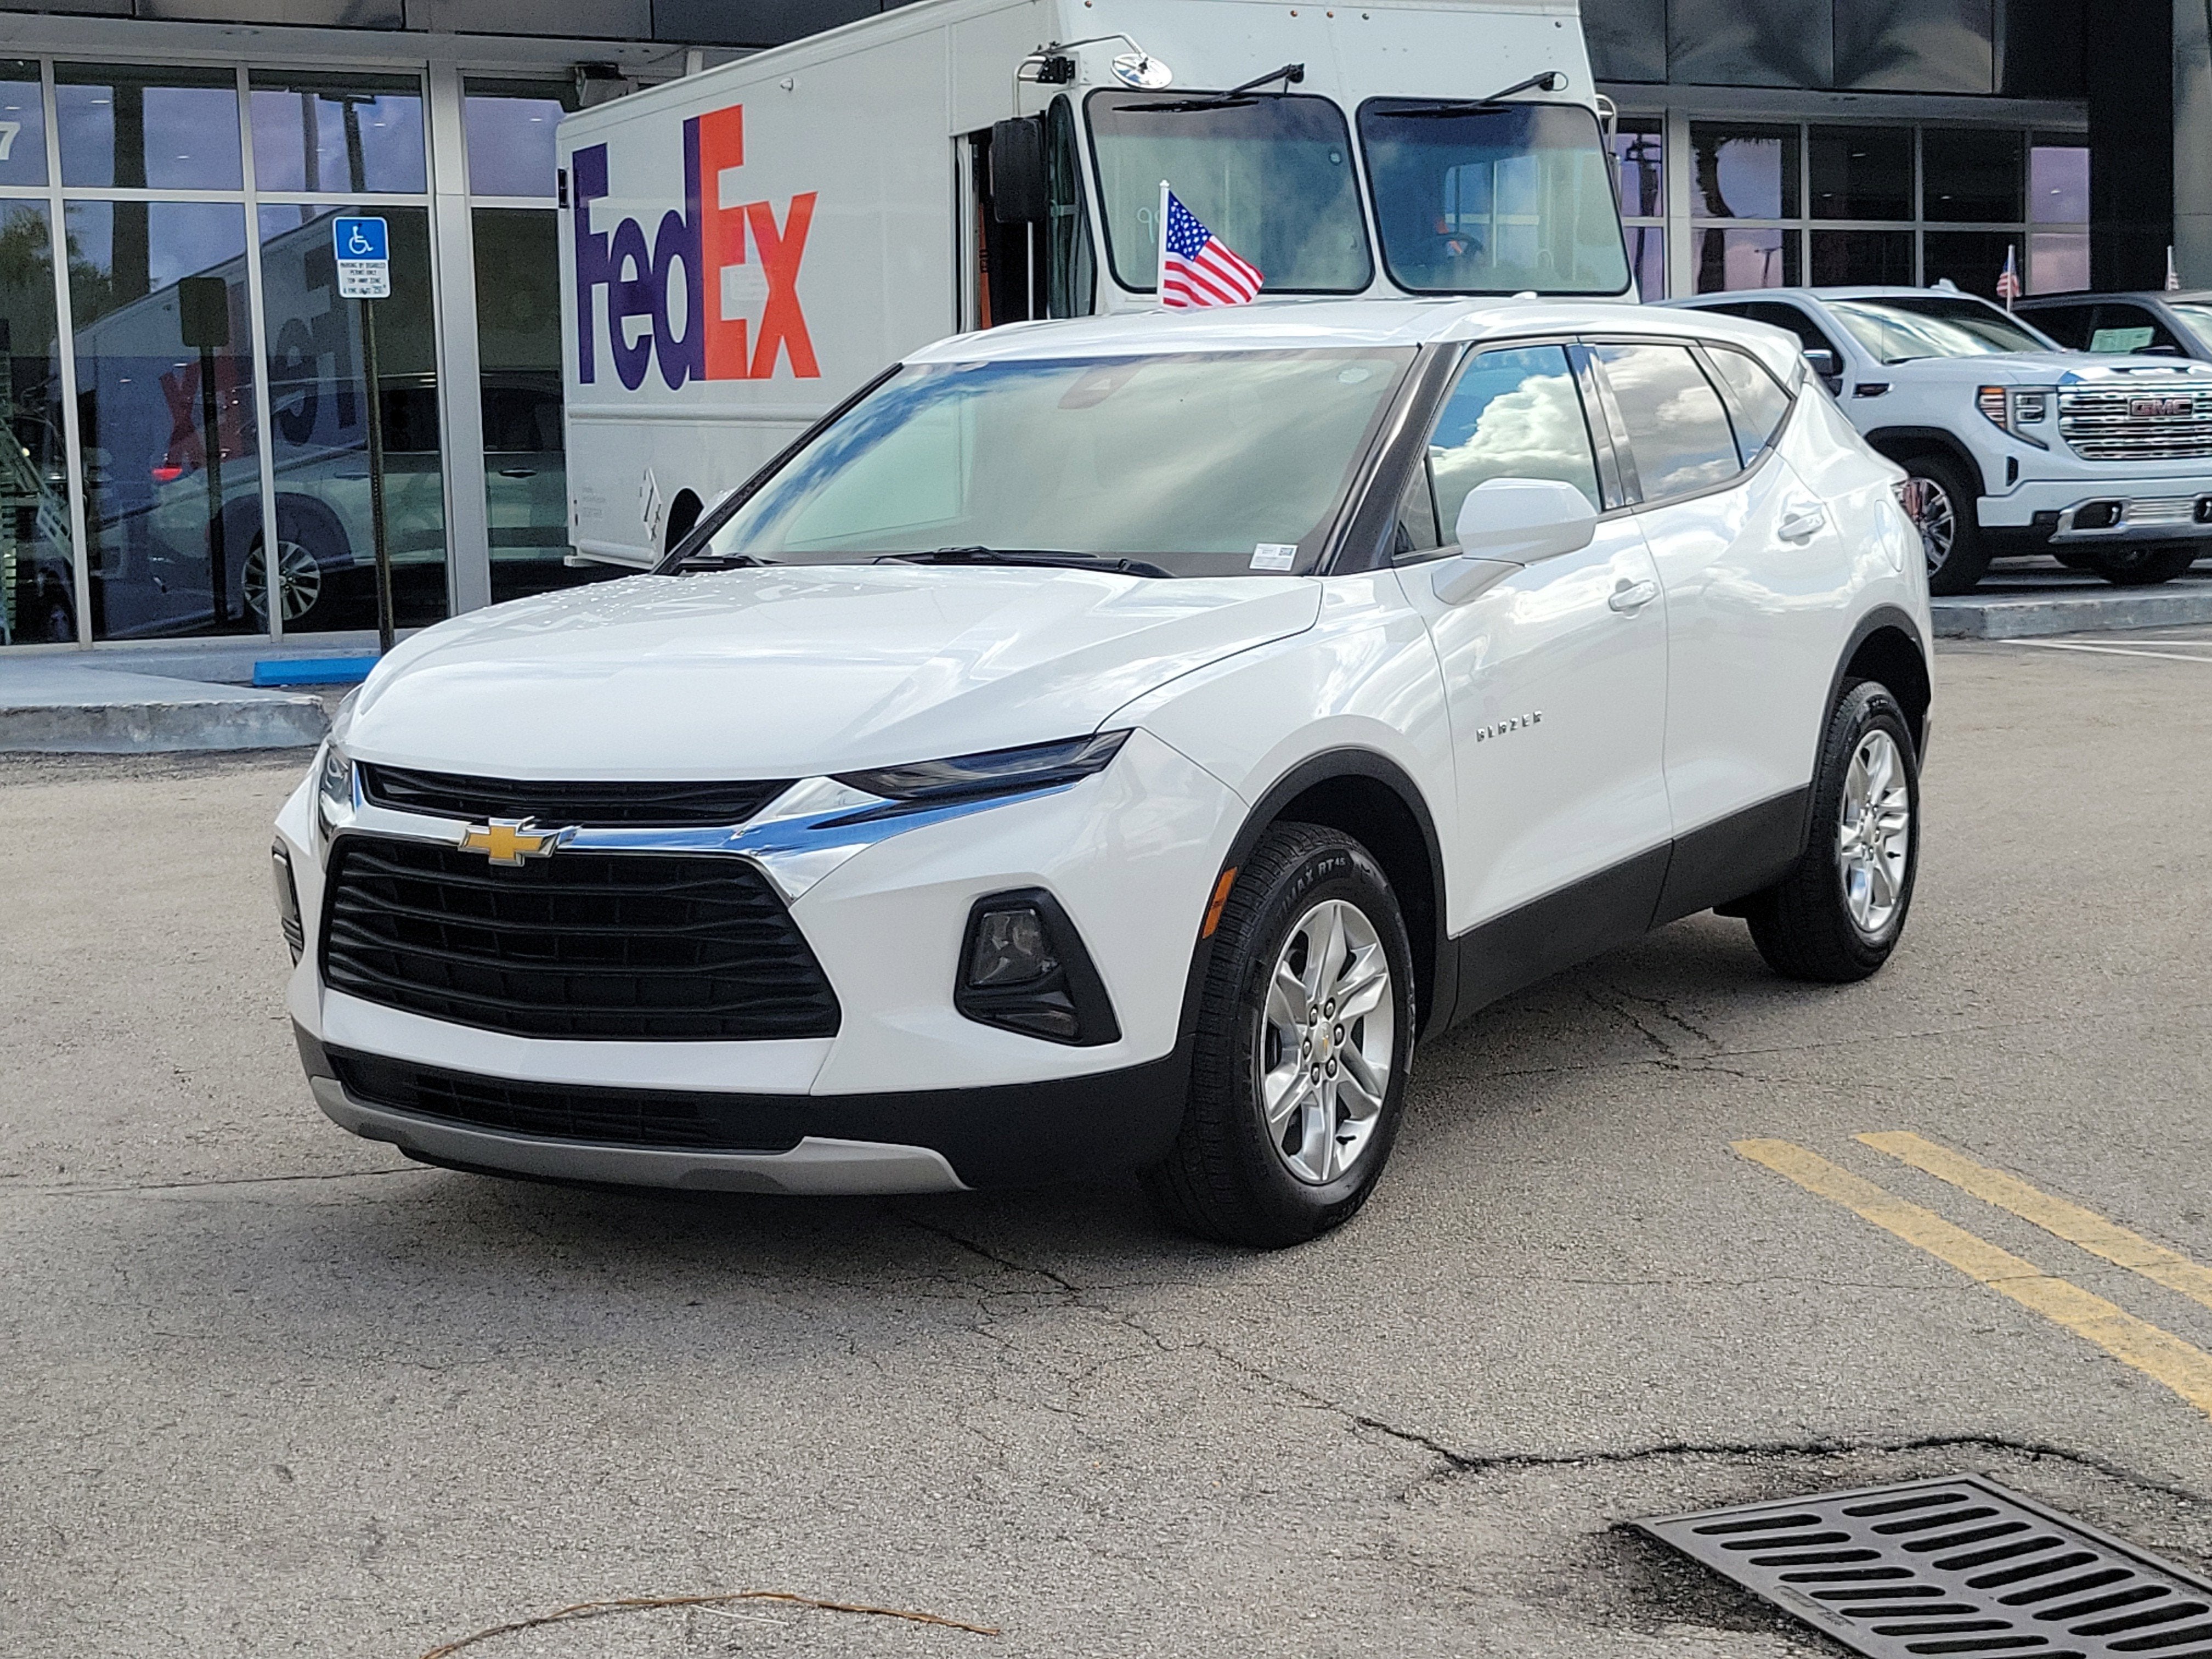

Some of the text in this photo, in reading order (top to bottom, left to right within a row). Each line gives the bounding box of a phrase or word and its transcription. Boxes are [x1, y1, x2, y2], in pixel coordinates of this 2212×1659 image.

[0, 121, 20, 160] 7
[572, 104, 821, 391] FedEx
[2131, 399, 2192, 415] GMC
[1476, 710, 1542, 742] BLAZER
